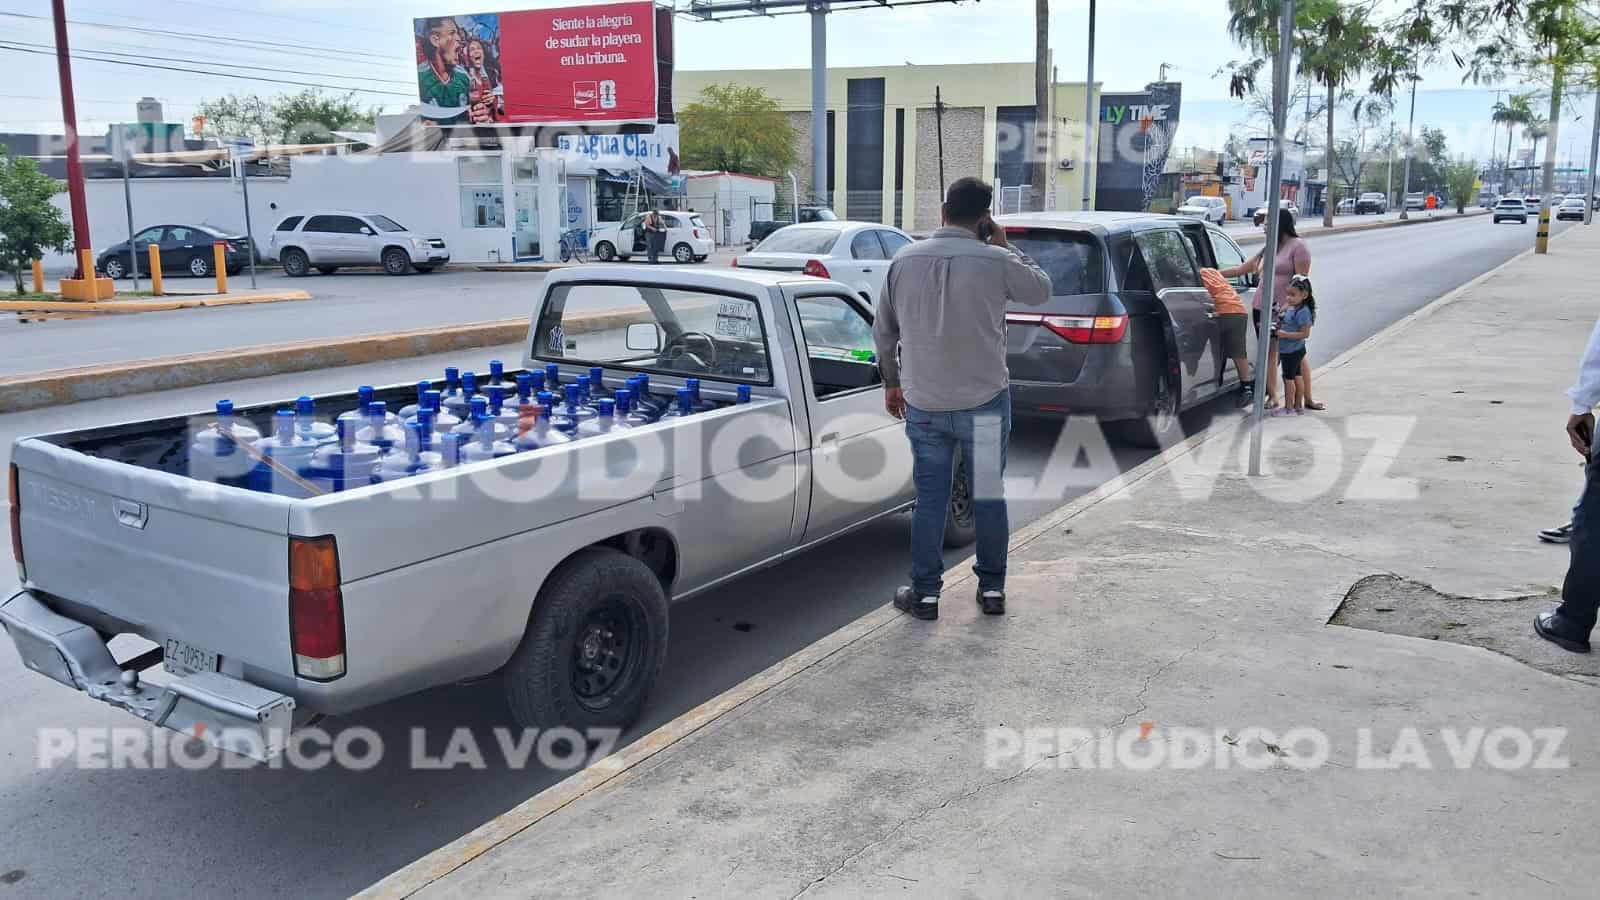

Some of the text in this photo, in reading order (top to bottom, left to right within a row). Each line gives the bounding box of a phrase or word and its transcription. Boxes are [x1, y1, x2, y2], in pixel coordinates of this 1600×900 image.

[552, 17, 584, 31] Siente
[586, 15, 596, 29] la
[545, 32, 642, 49] de sudar la playera
[560, 51, 627, 66] en la tribuna.
[1129, 103, 1171, 121] TIME
[575, 135, 619, 160] Agua
